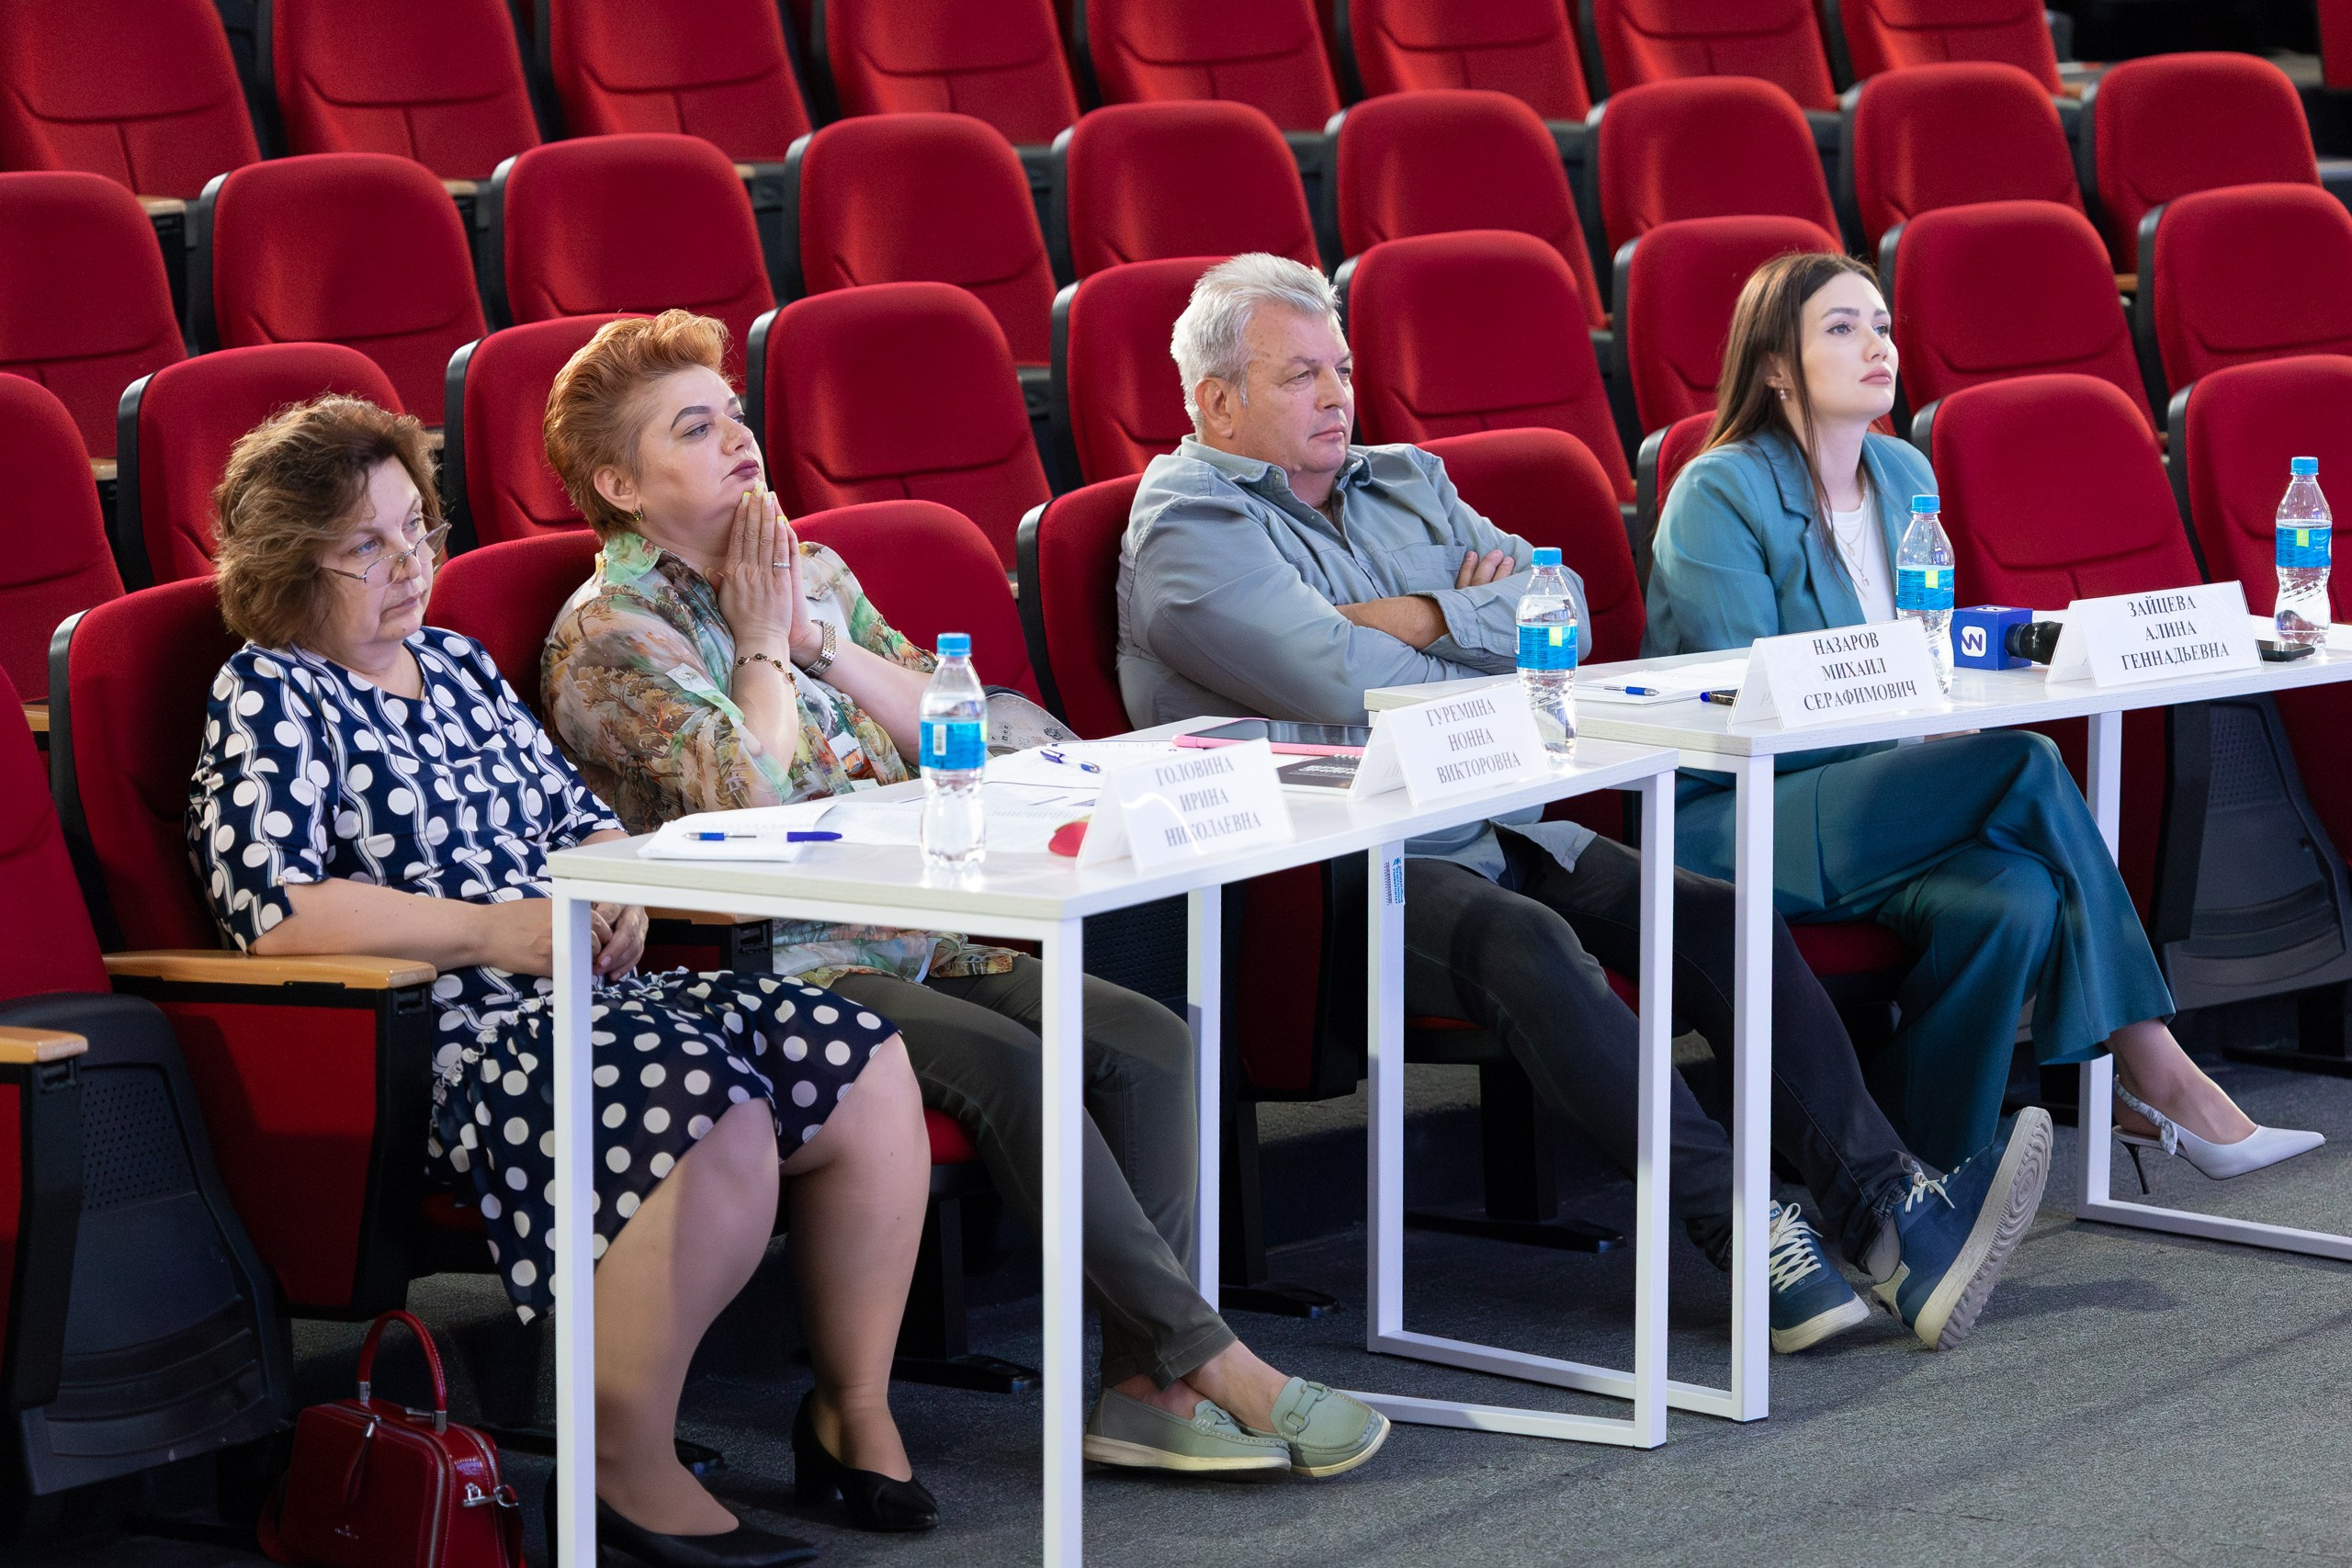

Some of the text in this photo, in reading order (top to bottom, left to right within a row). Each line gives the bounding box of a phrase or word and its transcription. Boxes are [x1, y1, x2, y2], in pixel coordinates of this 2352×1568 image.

[2127, 594, 2197, 617] ЗАЙЦЕВА
[1813, 632, 1880, 656] НАЗАРОВ
[2144, 621, 2198, 641] АЛИНА
[2120, 641, 2230, 671] ГЕННАДЬЕВНА
[1821, 658, 1888, 682] МИХАИЛ
[1804, 680, 1918, 711] СЕРАФИМОВИЧ
[1426, 698, 1497, 727] ГУРЕМИНА
[1448, 728, 1495, 752] НОННА
[1156, 756, 1235, 786] ГОЛОВИНА
[1436, 751, 1521, 784] ВИКТОРОВНА
[1180, 787, 1230, 813] ИРИНА
[1165, 811, 1262, 847] НИКОЛАЕВНА
